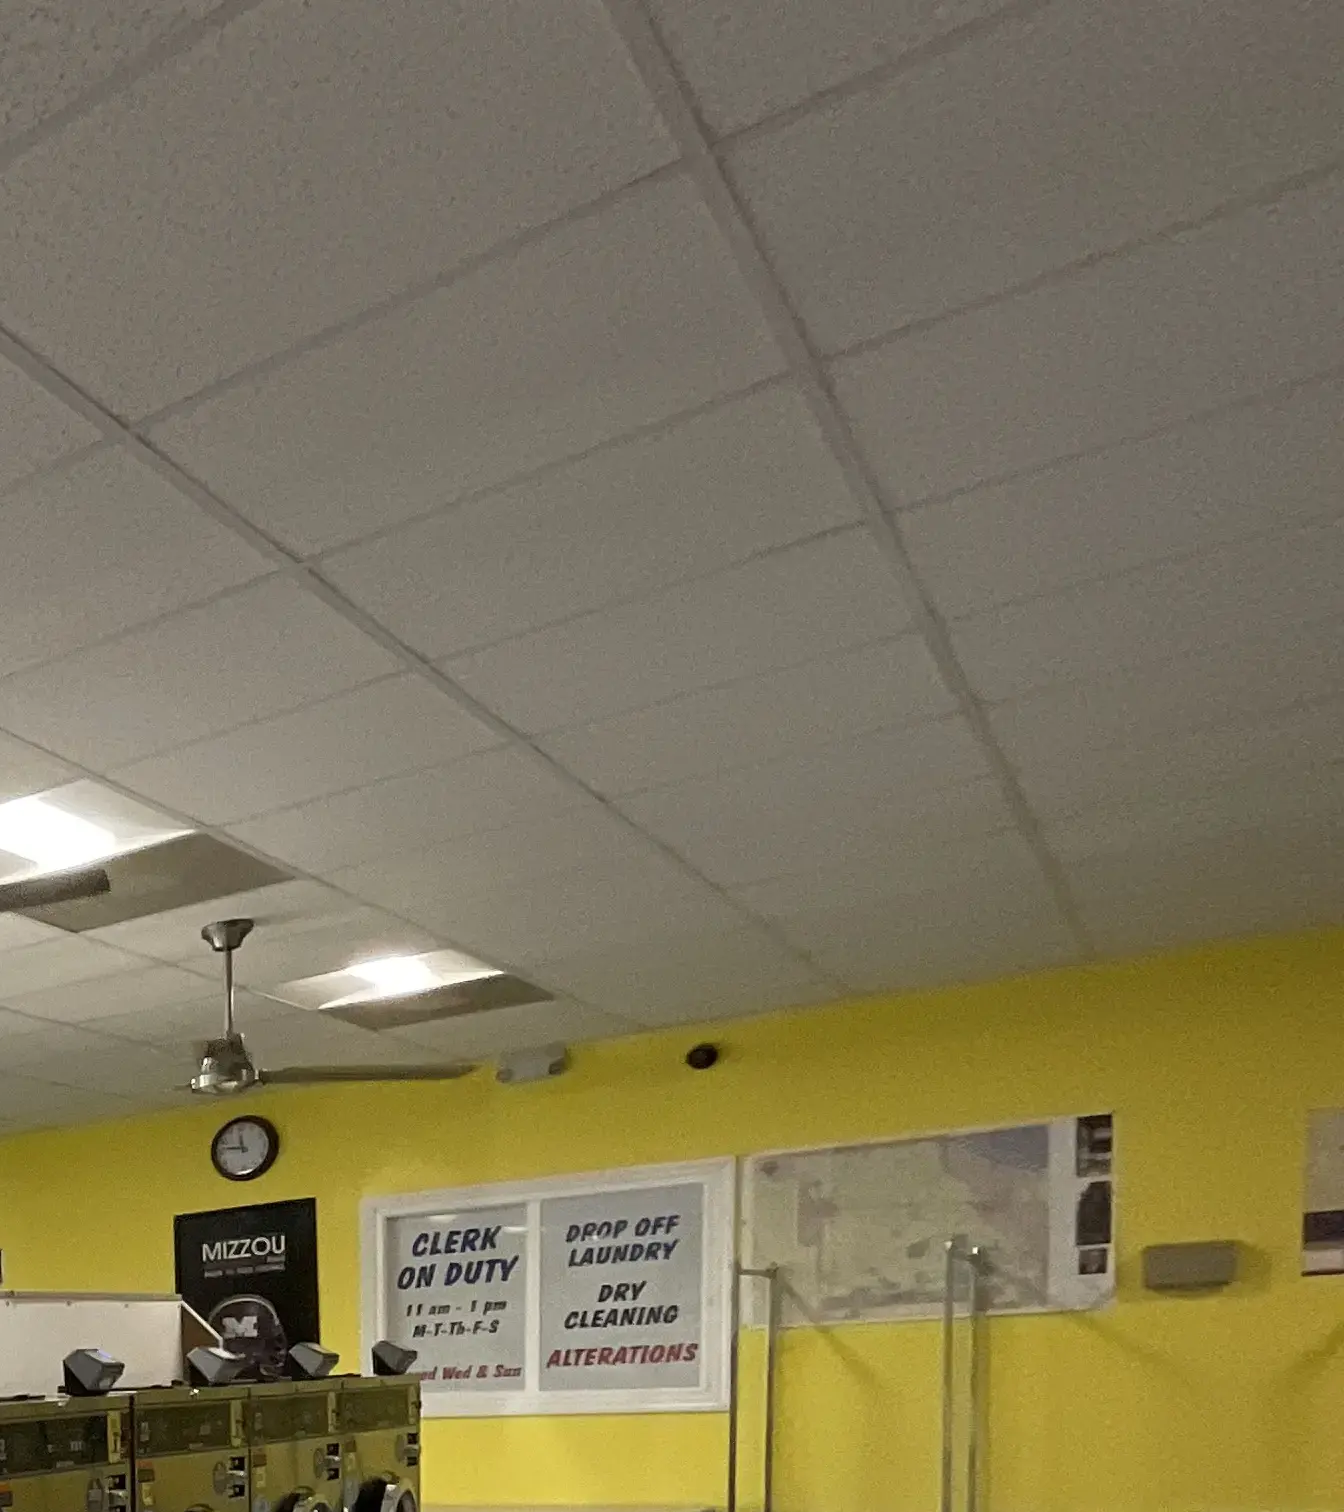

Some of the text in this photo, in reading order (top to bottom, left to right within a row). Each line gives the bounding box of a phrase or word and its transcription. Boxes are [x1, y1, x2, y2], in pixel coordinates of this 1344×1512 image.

[413, 1225, 501, 1257] CLERK
[566, 1215, 680, 1242] DROP OFF
[202, 1235, 285, 1262] MIZZOU
[569, 1239, 680, 1268] LAUNDRY
[398, 1255, 519, 1290] ON DUTY
[598, 1281, 647, 1302] DRY
[429, 1305, 450, 1315] am
[483, 1301, 507, 1315] pm
[564, 1305, 678, 1329] CLEANING
[413, 1319, 499, 1337] M-T-Th-F-S
[546, 1343, 699, 1368] ALTERATIONS
[443, 1365, 473, 1380] Wed
[476, 1365, 488, 1378] &
[493, 1364, 521, 1377] Sun
